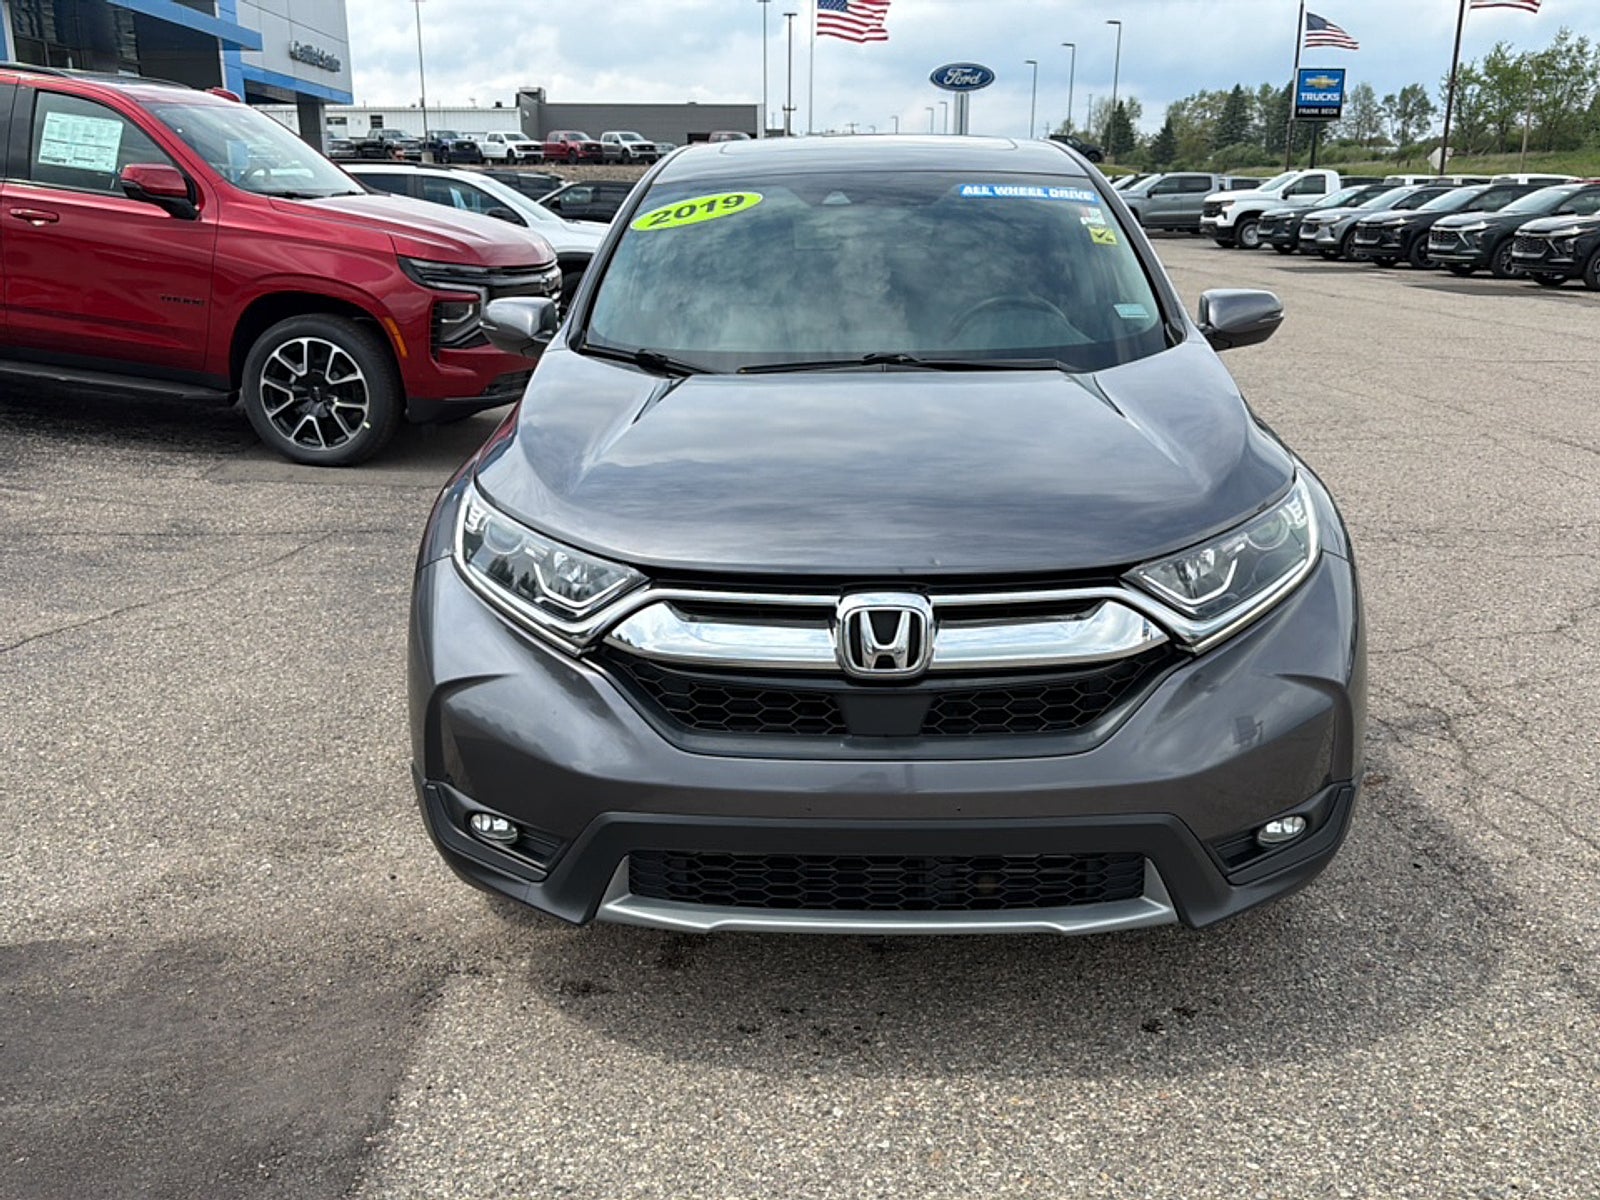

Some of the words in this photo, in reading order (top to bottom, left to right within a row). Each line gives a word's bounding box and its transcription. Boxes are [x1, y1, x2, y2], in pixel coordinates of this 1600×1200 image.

[943, 68, 983, 85] Ford
[1301, 92, 1340, 102] TRUCKS
[962, 185, 992, 195] ALL
[993, 185, 1048, 198] WHEEL
[1048, 187, 1096, 201] DRIVE
[648, 195, 745, 226] 2019
